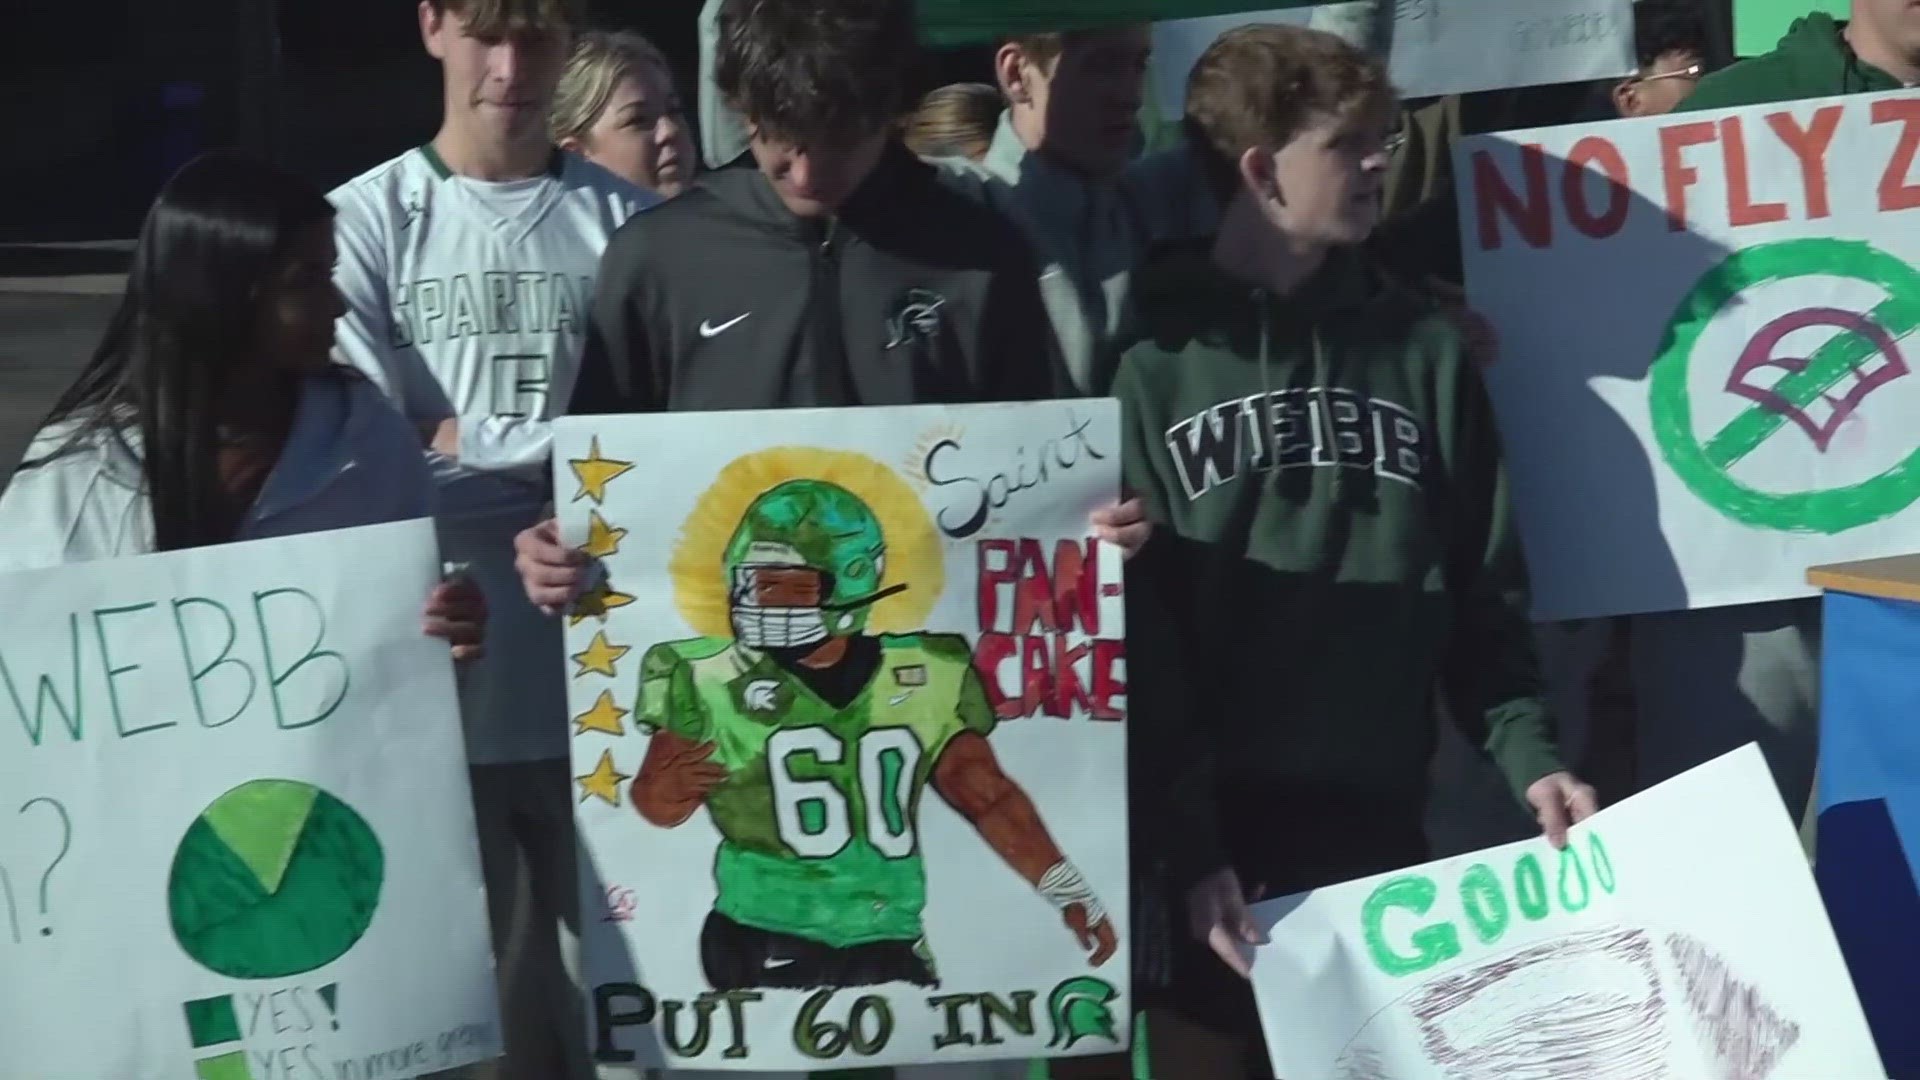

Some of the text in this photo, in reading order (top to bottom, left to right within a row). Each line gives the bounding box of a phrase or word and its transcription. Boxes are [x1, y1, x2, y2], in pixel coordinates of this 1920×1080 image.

[1472, 136, 1631, 251] NO
[1658, 105, 1844, 233] FLY
[924, 411, 1106, 539] Saint
[1165, 387, 1424, 501] WEBB
[0, 587, 350, 746] WEBB
[974, 631, 1128, 721] CAKE
[766, 724, 924, 859] 60
[247, 982, 340, 1036] YES!
[592, 982, 1038, 1062] PUT 60 IN
